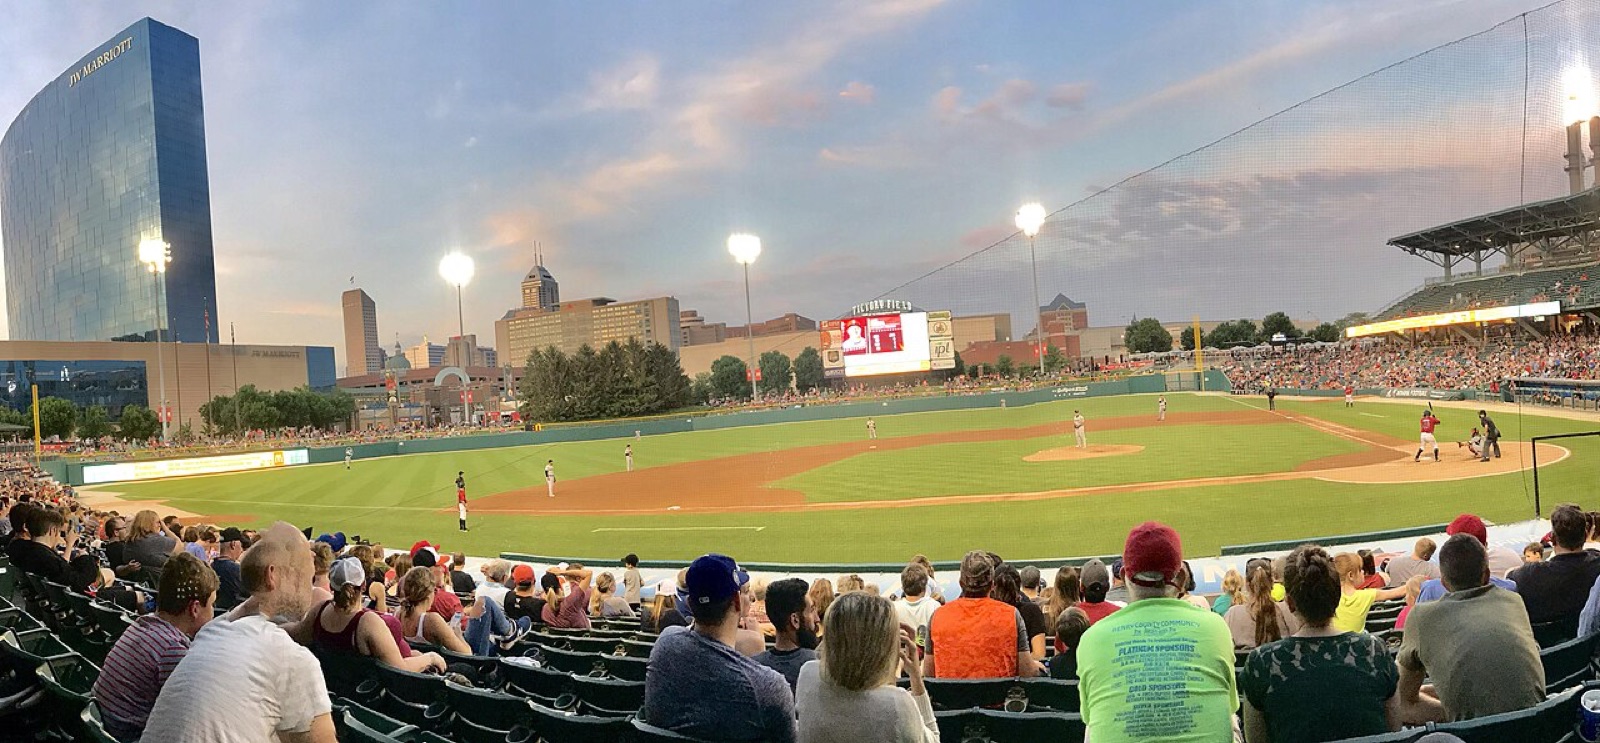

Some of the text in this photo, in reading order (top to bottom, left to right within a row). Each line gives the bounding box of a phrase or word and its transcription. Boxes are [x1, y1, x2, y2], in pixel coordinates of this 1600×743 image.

[69, 36, 133, 87] JW MARRIOTT
[852, 299, 912, 315] VICTORY FIELD
[935, 341, 950, 357] ipl
[1118, 644, 1195, 656] PLATINUM SPONSORS
[1129, 684, 1146, 693] GOLD
[1148, 682, 1186, 691] SPONSORS
